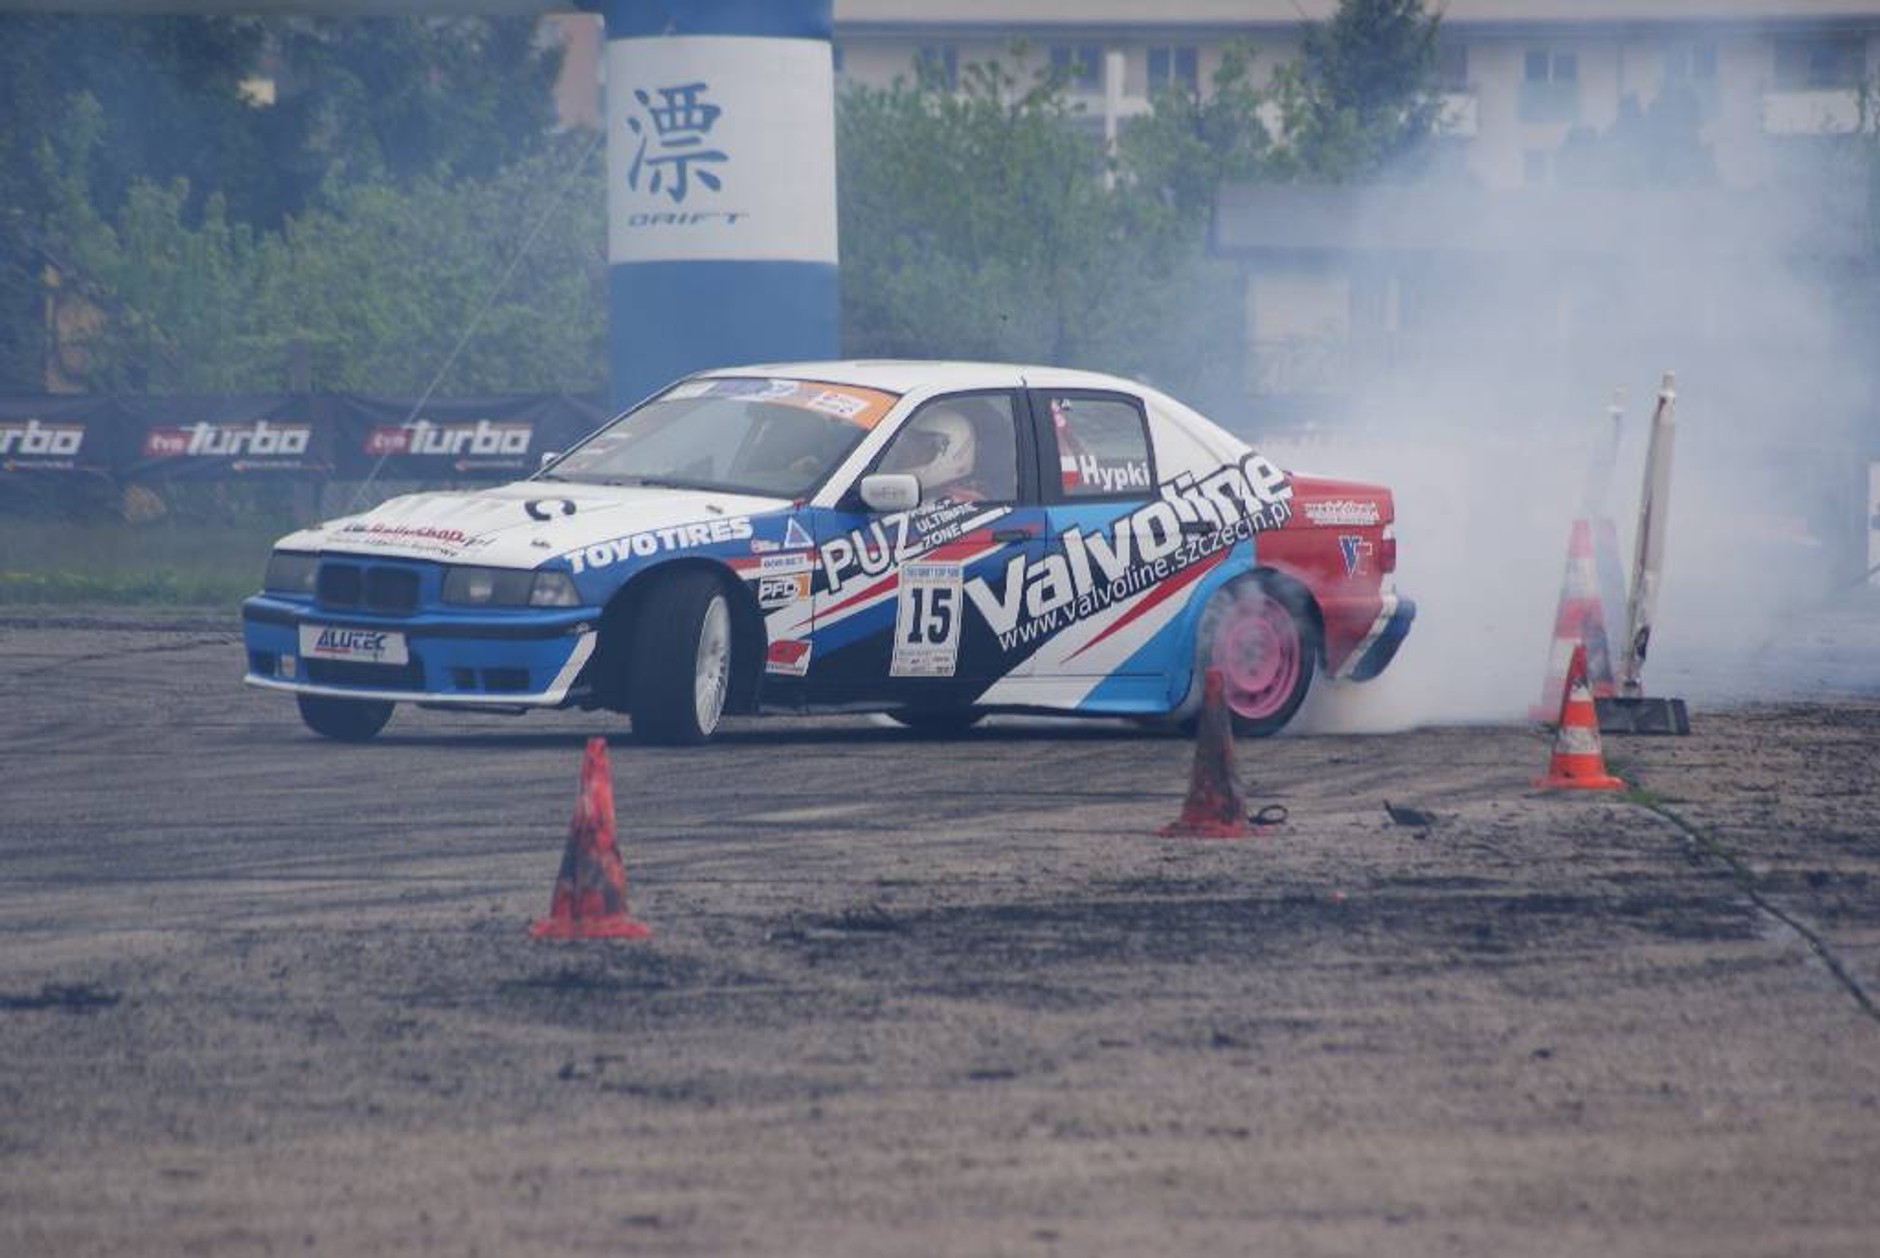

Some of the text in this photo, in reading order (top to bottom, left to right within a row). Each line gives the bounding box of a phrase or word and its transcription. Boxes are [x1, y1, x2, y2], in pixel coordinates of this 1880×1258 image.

[626, 81, 729, 204] 漂
[627, 211, 749, 227] DRIFT
[1079, 455, 1150, 491] Hypki
[564, 514, 754, 574] TOYO TIRES
[821, 511, 920, 595] PUZ
[923, 522, 962, 550] ZONE
[963, 453, 1293, 637] Valvoline
[998, 498, 1292, 651] www.valvoline.szczecin.pl
[907, 588, 952, 644] 15
